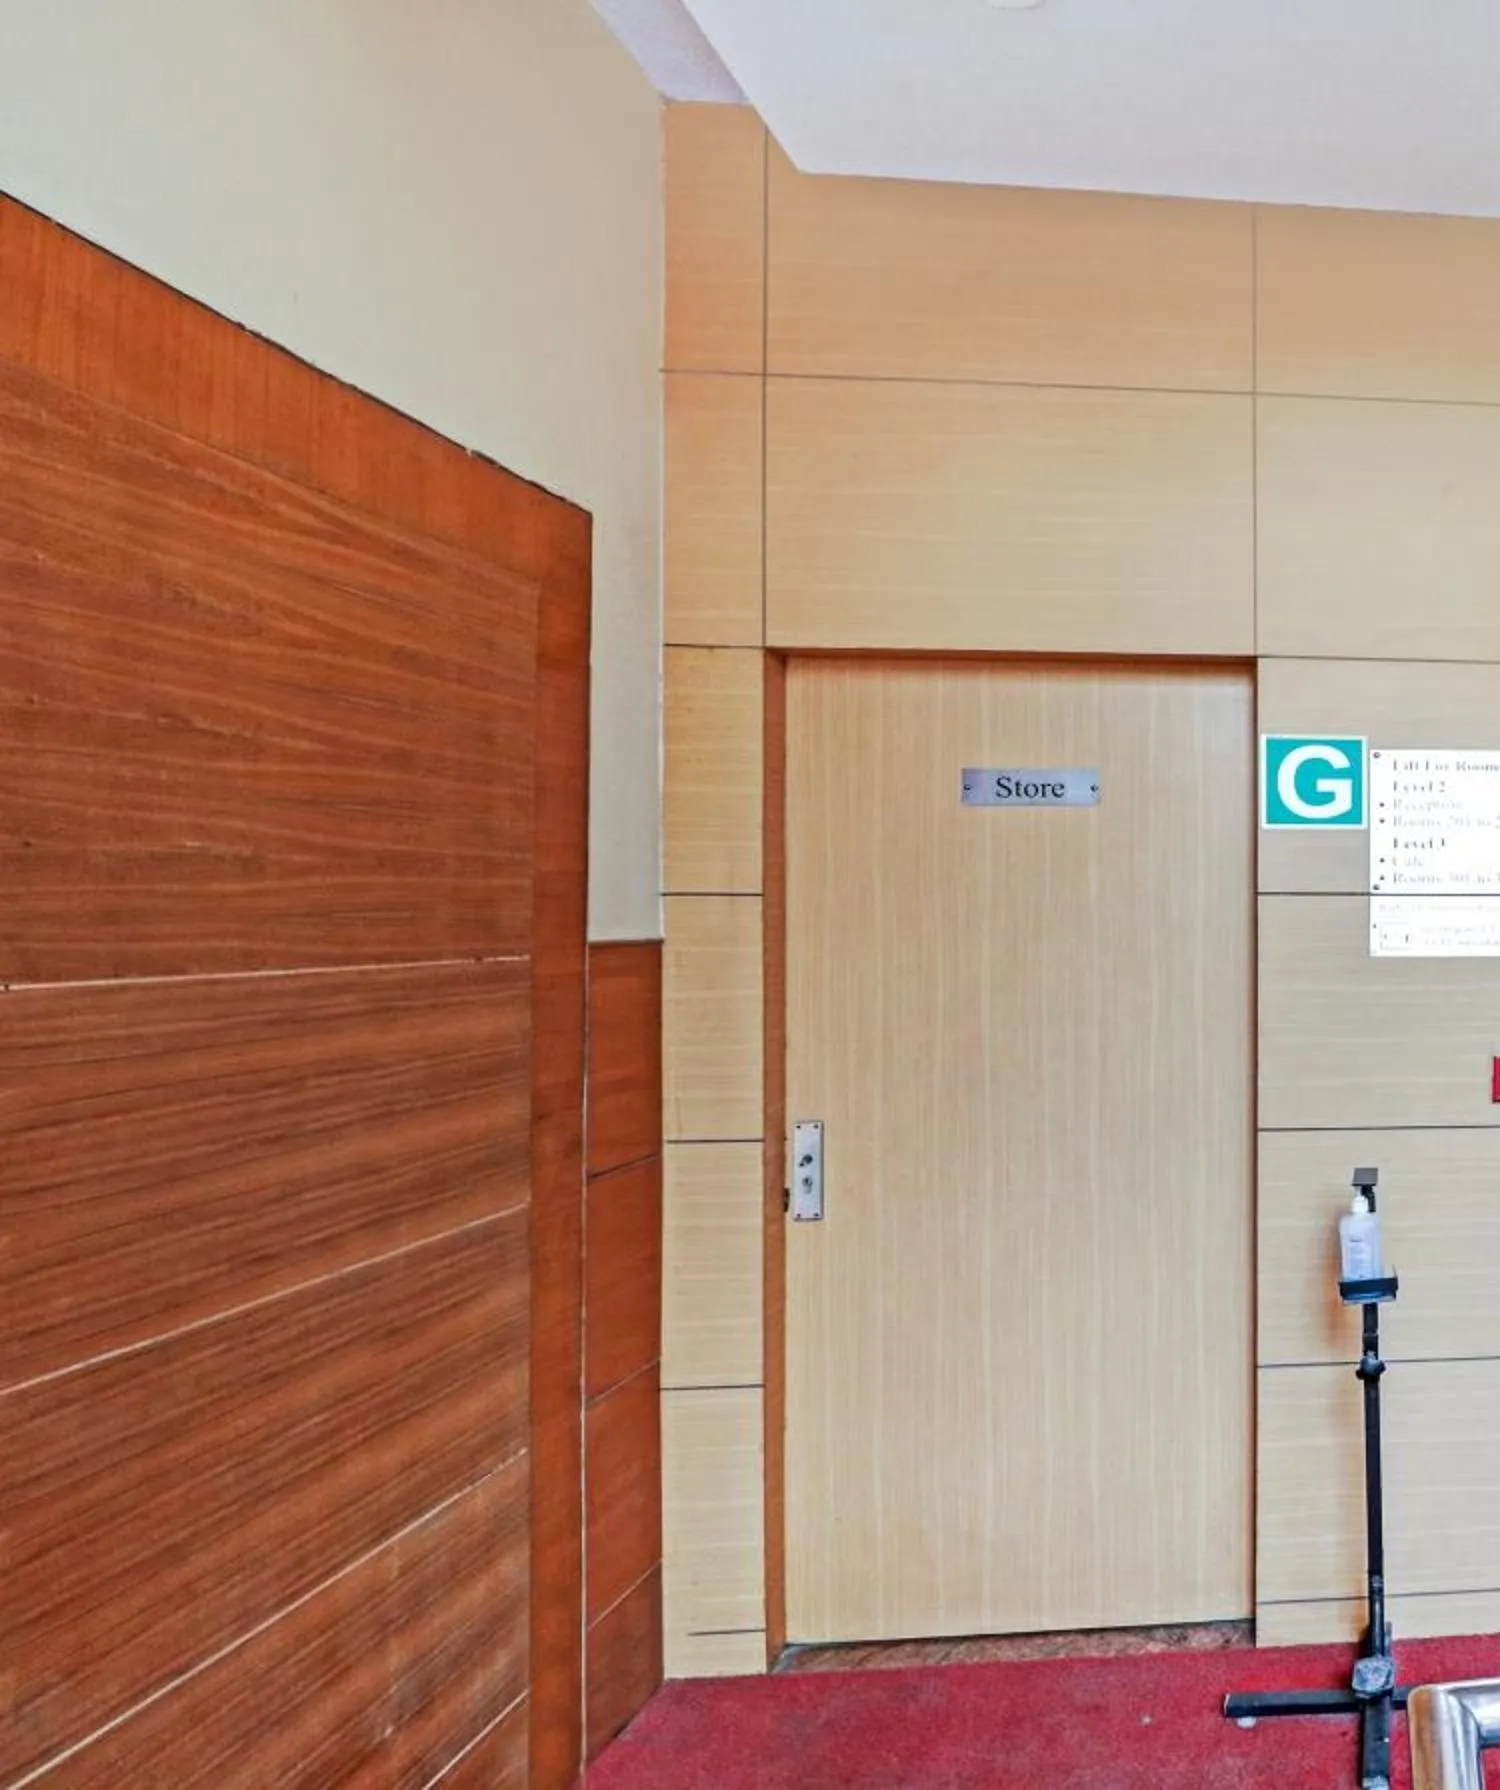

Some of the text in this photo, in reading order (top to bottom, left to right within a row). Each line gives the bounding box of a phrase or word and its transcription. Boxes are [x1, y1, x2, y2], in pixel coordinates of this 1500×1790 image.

[995, 775, 1065, 798] Store
[1276, 744, 1353, 819] G
[1393, 780, 1446, 793] Level 2
[1393, 837, 1433, 849] Level
